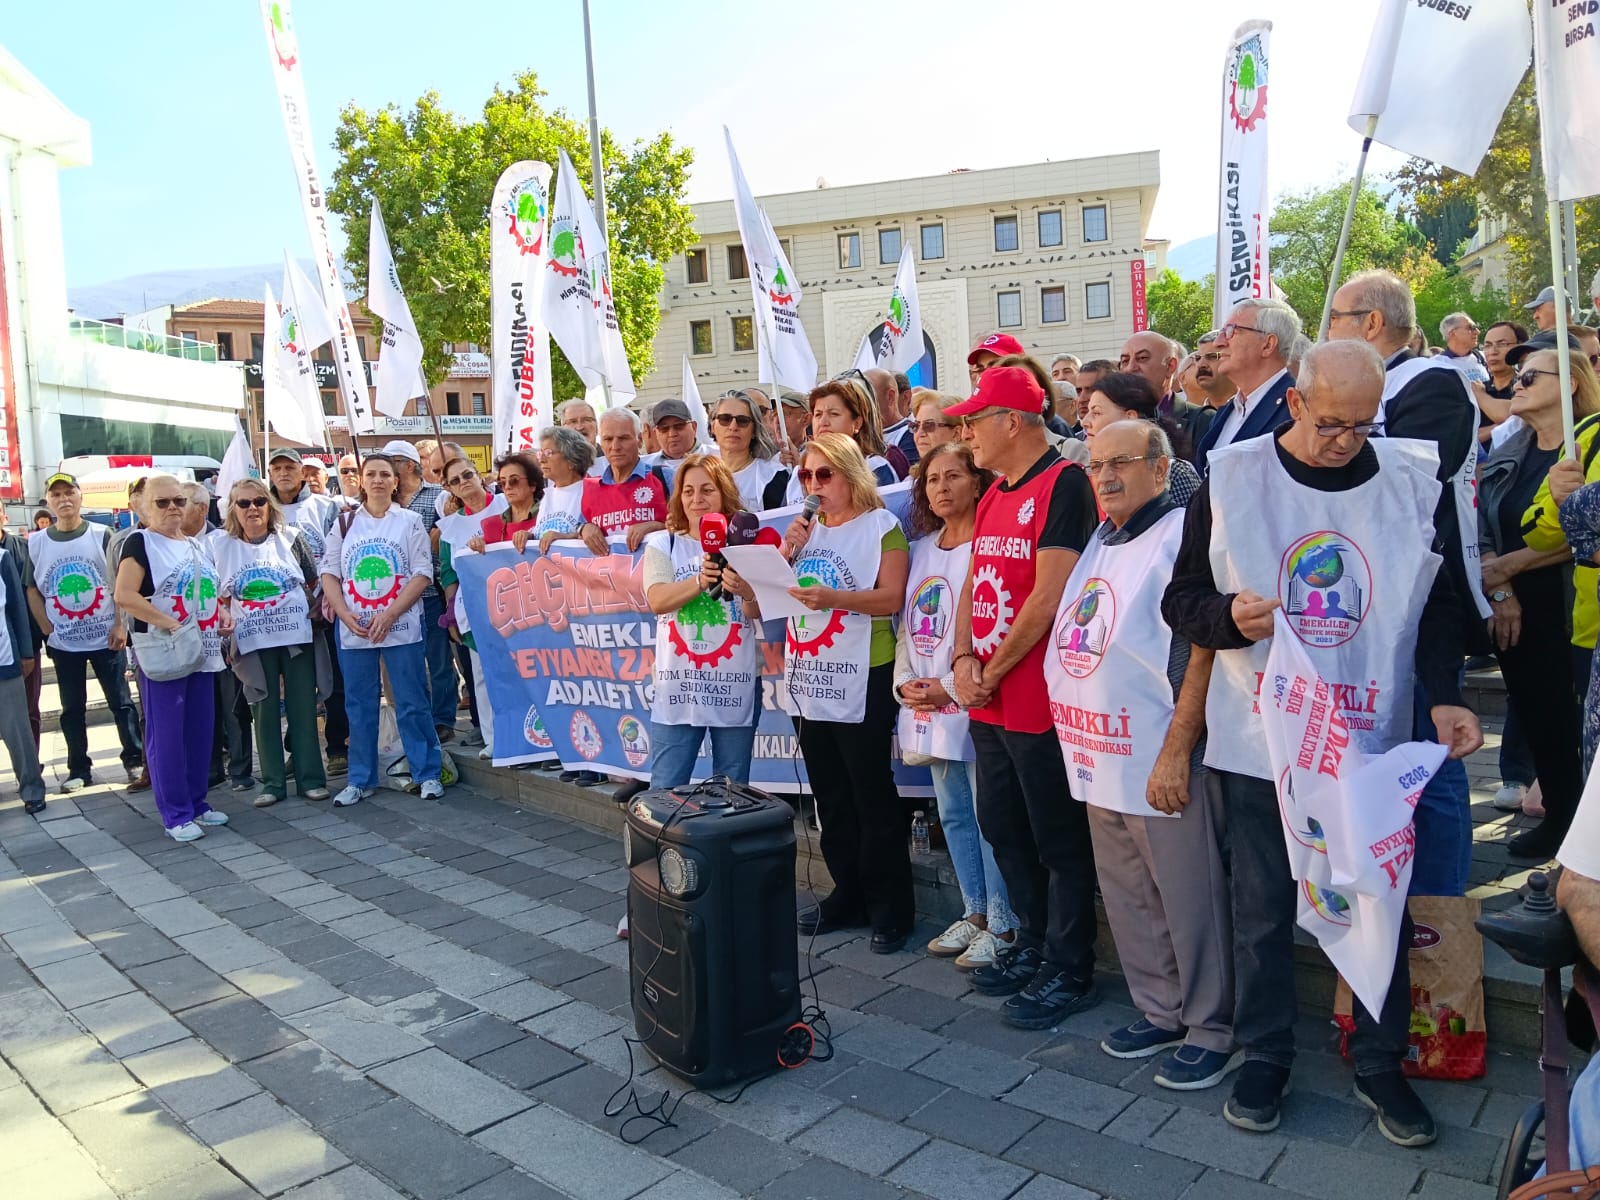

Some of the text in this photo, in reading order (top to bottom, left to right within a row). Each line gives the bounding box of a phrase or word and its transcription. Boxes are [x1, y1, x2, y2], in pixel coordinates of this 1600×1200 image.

[1417, 0, 1472, 21] UBESİ
[1568, 0, 1600, 23] SEND
[1226, 162, 1251, 292] SENDİKASI
[972, 594, 997, 620] DİSK
[568, 621, 657, 649] EMEKL
[616, 648, 657, 681] ZA
[658, 670, 680, 681] TÜM
[545, 678, 635, 710] ADALET
[1050, 702, 1132, 739] EMEKLİ
[1084, 738, 1133, 756] SENDİKASI
[1398, 765, 1430, 790] 2023
